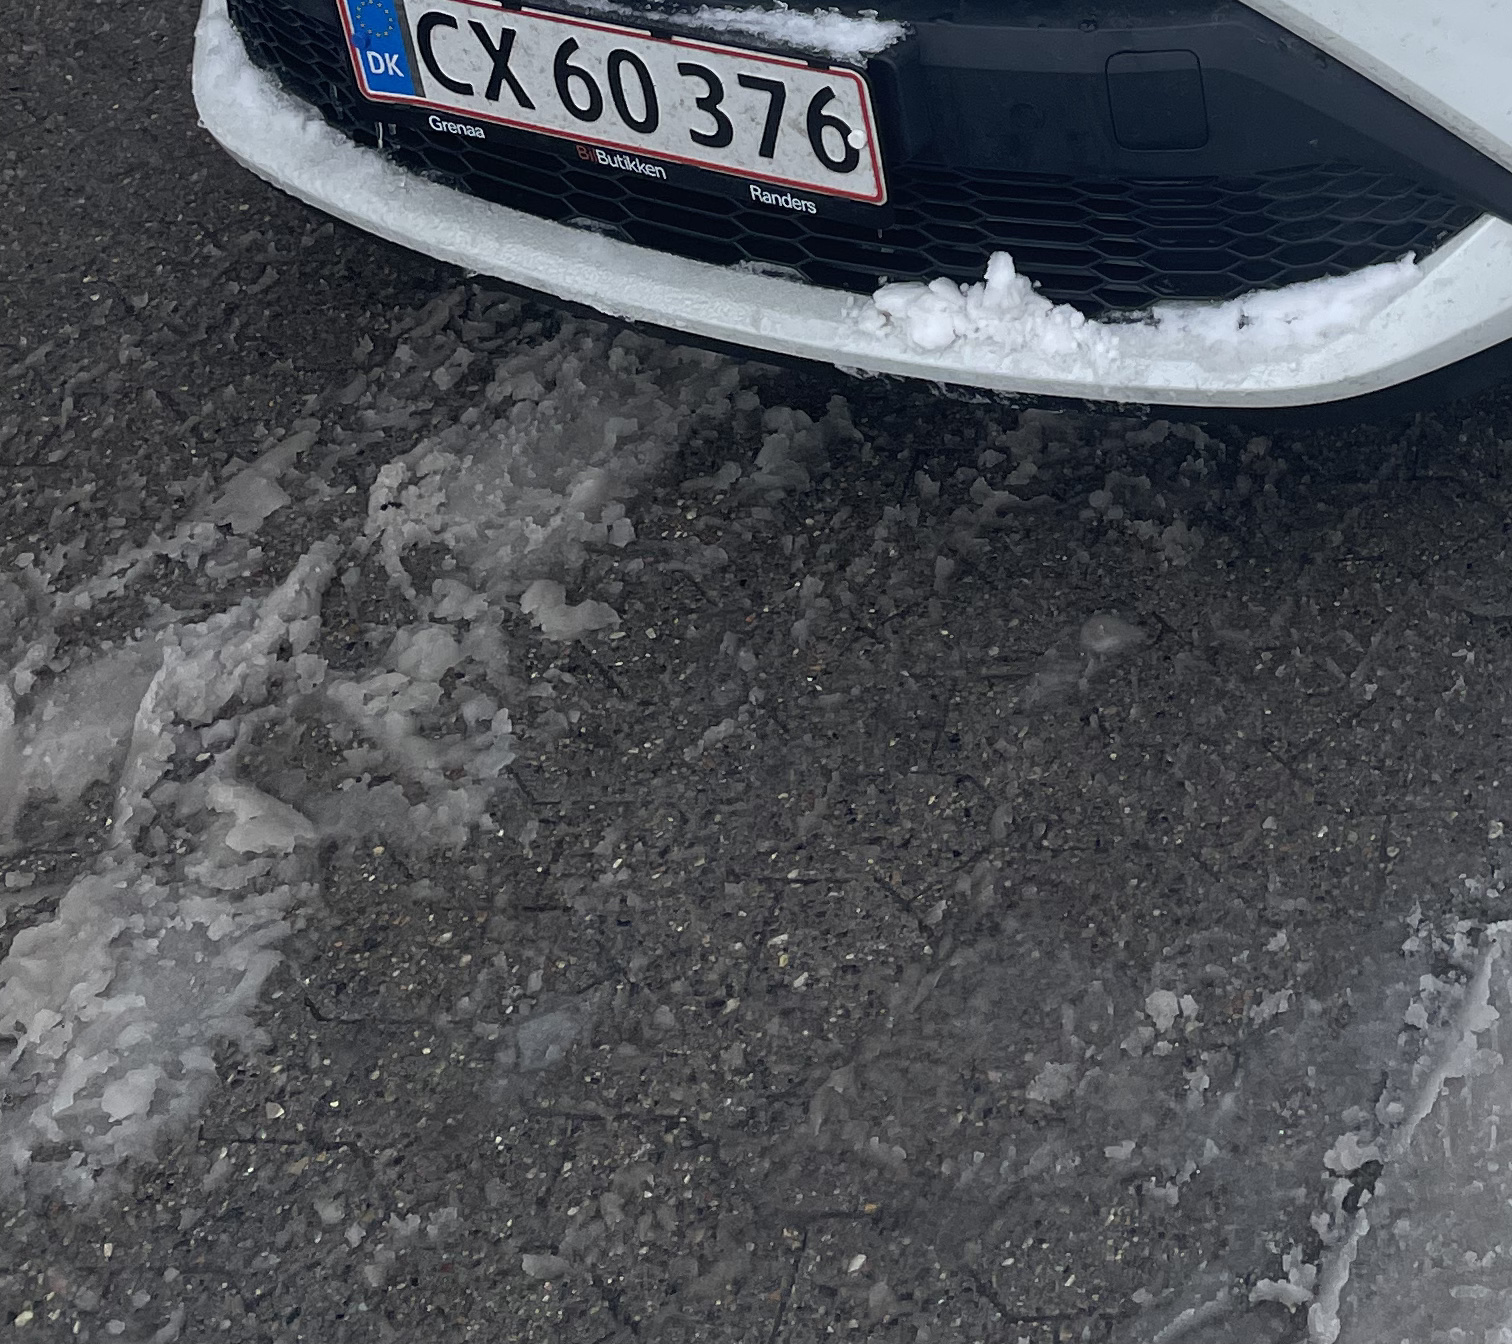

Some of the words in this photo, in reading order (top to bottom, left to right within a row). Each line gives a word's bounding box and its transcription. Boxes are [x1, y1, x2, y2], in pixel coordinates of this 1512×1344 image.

[366, 51, 405, 78] DK
[417, 11, 536, 111] CX
[553, 36, 659, 135] 60
[677, 62, 860, 174] 376
[428, 115, 486, 139] Grenaa
[749, 184, 817, 214] Randers
